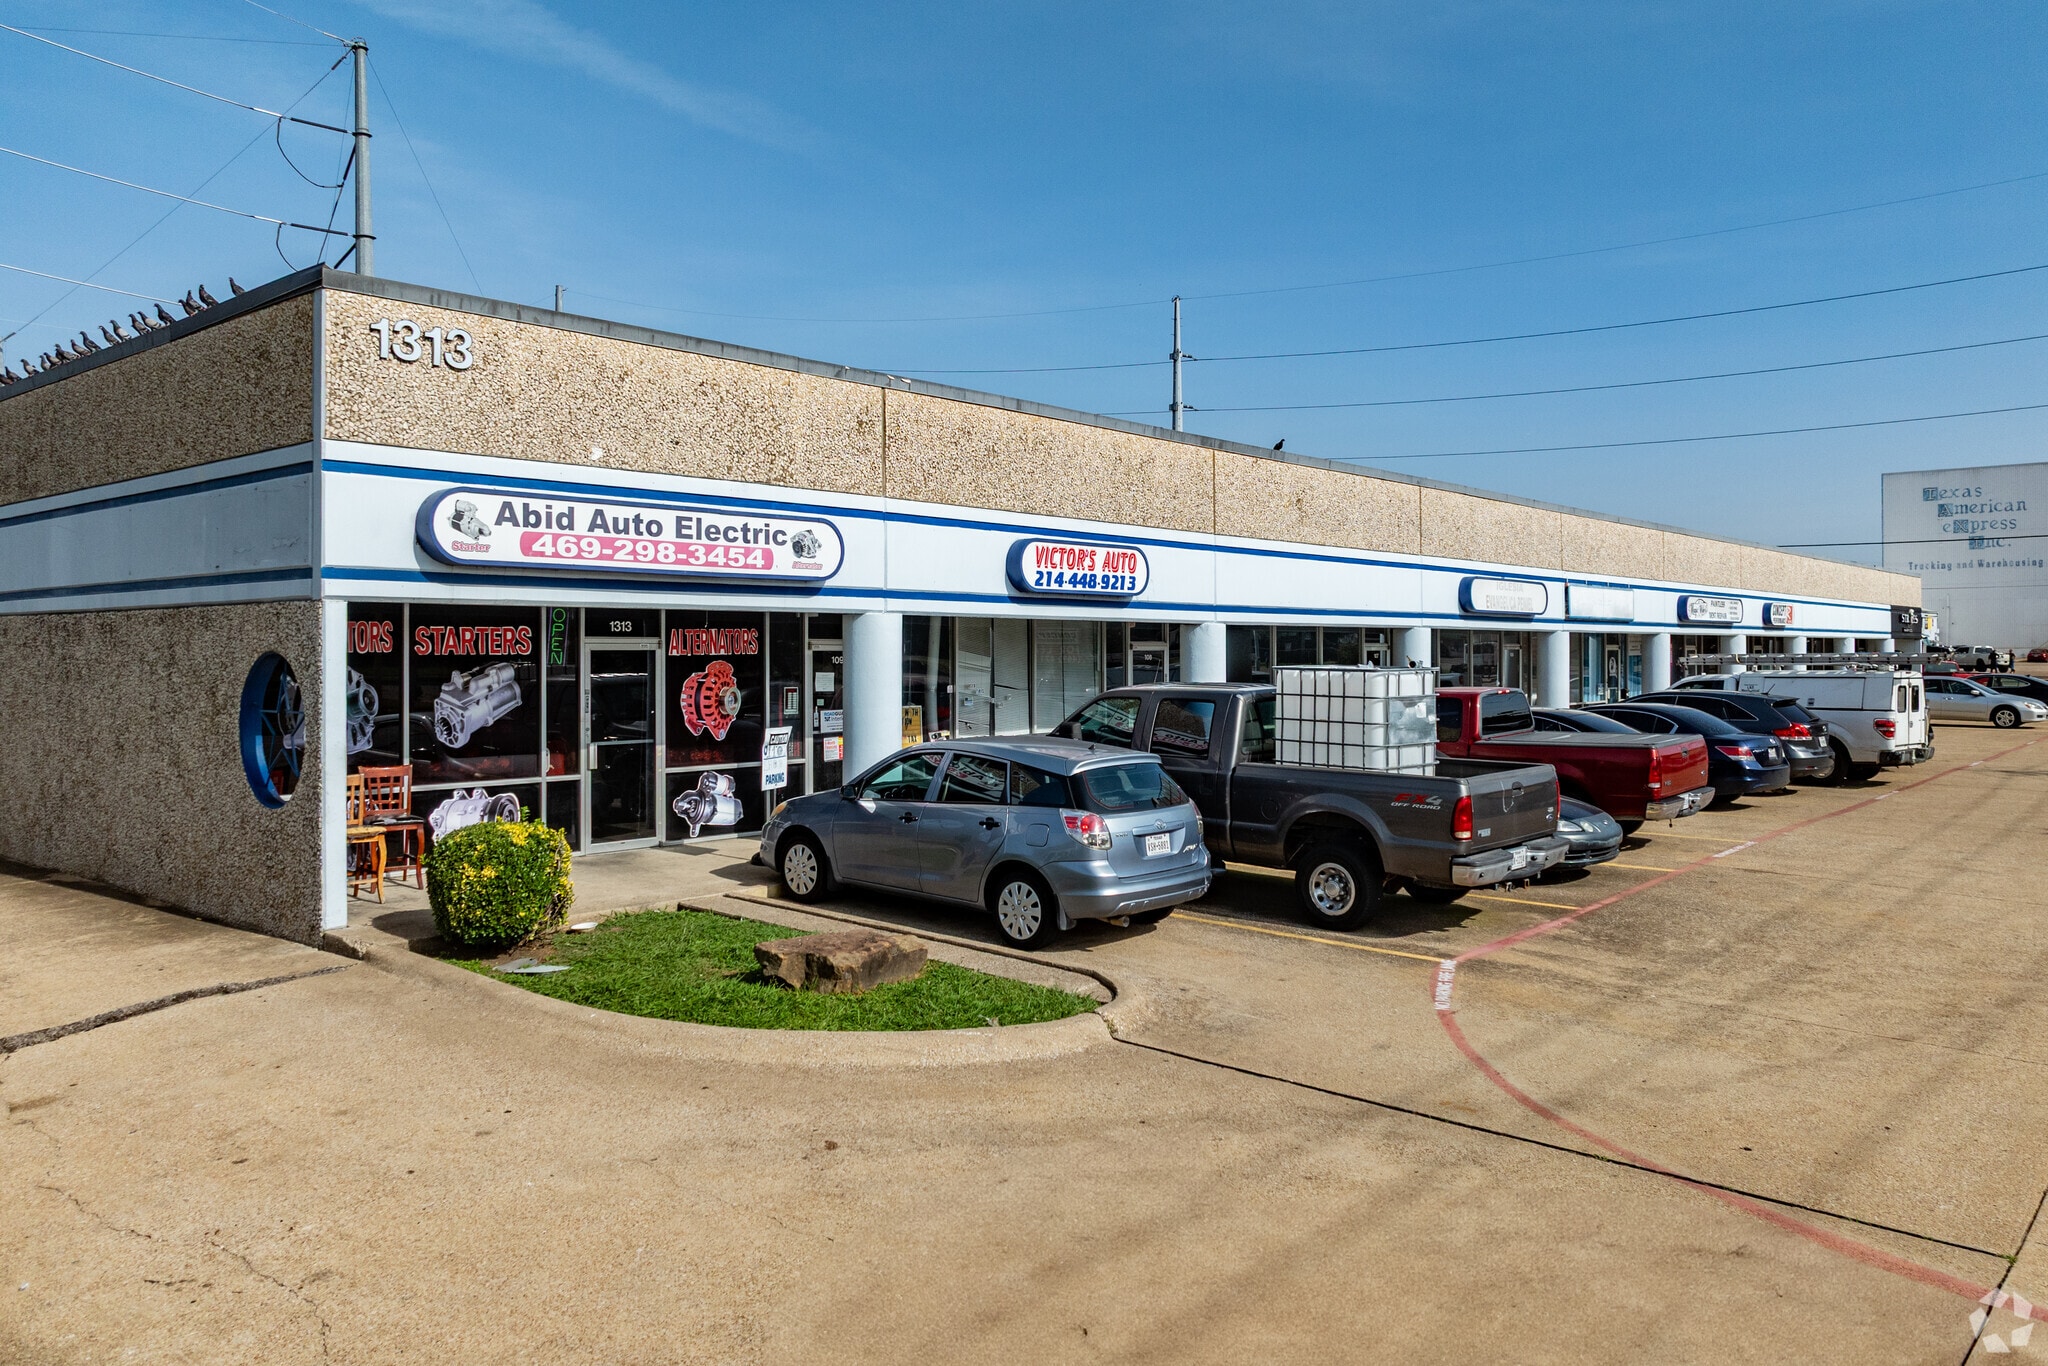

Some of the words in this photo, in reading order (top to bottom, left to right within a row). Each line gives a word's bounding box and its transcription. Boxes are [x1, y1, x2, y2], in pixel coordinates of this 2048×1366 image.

[370, 318, 473, 371] 1313
[1923, 486, 1982, 502] Texas
[1937, 499, 2028, 518] American
[494, 500, 575, 531] Abid
[588, 508, 663, 538] Auto
[675, 515, 788, 547] Electric
[452, 540, 491, 554] Starter
[1969, 535, 2012, 550] Inc.
[531, 534, 765, 569] 469-298-3454
[1035, 545, 1097, 572] VICTOR'S
[1102, 551, 1138, 574] AUTO
[1908, 561, 1952, 571] Trucking
[1956, 560, 1974, 569] and
[1977, 557, 2044, 569] Warehousing
[1496, 581, 1524, 592] IGLESIA
[609, 620, 633, 632] 1313
[414, 625, 532, 656] STARTERS
[550, 608, 566, 665] OPEN
[668, 628, 759, 656] ALTERNATORS
[907, 735, 918, 744] TAX
[765, 772, 785, 785] PARKING
[1393, 793, 1444, 806] FX4
